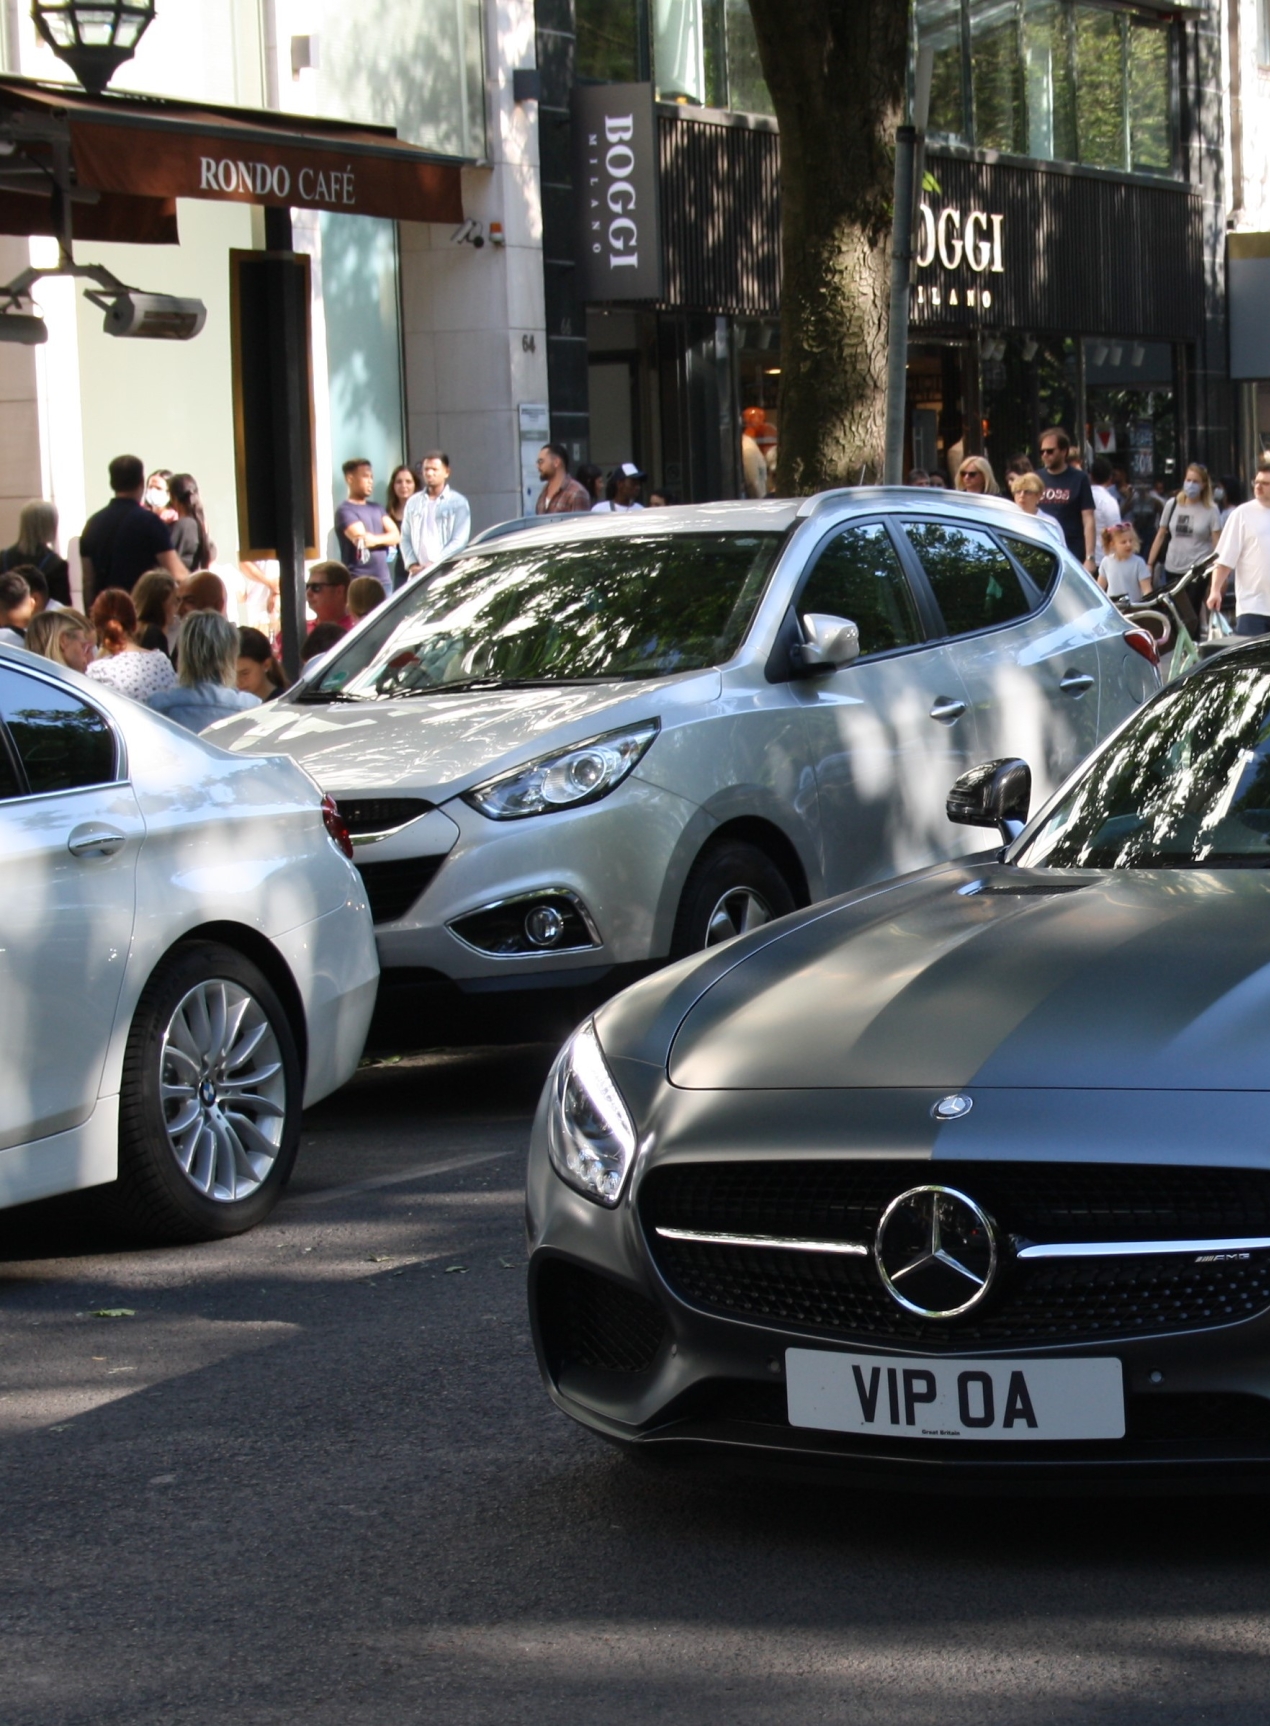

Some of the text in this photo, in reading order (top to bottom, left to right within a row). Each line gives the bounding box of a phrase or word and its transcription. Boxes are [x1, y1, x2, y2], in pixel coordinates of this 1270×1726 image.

[200, 157, 356, 204] RONDO CAFÉ
[588, 133, 602, 253] MILANO
[604, 113, 639, 270] BOGGI
[917, 203, 1005, 273] OGGI
[917, 285, 991, 309] ILANO
[522, 334, 536, 354] 64
